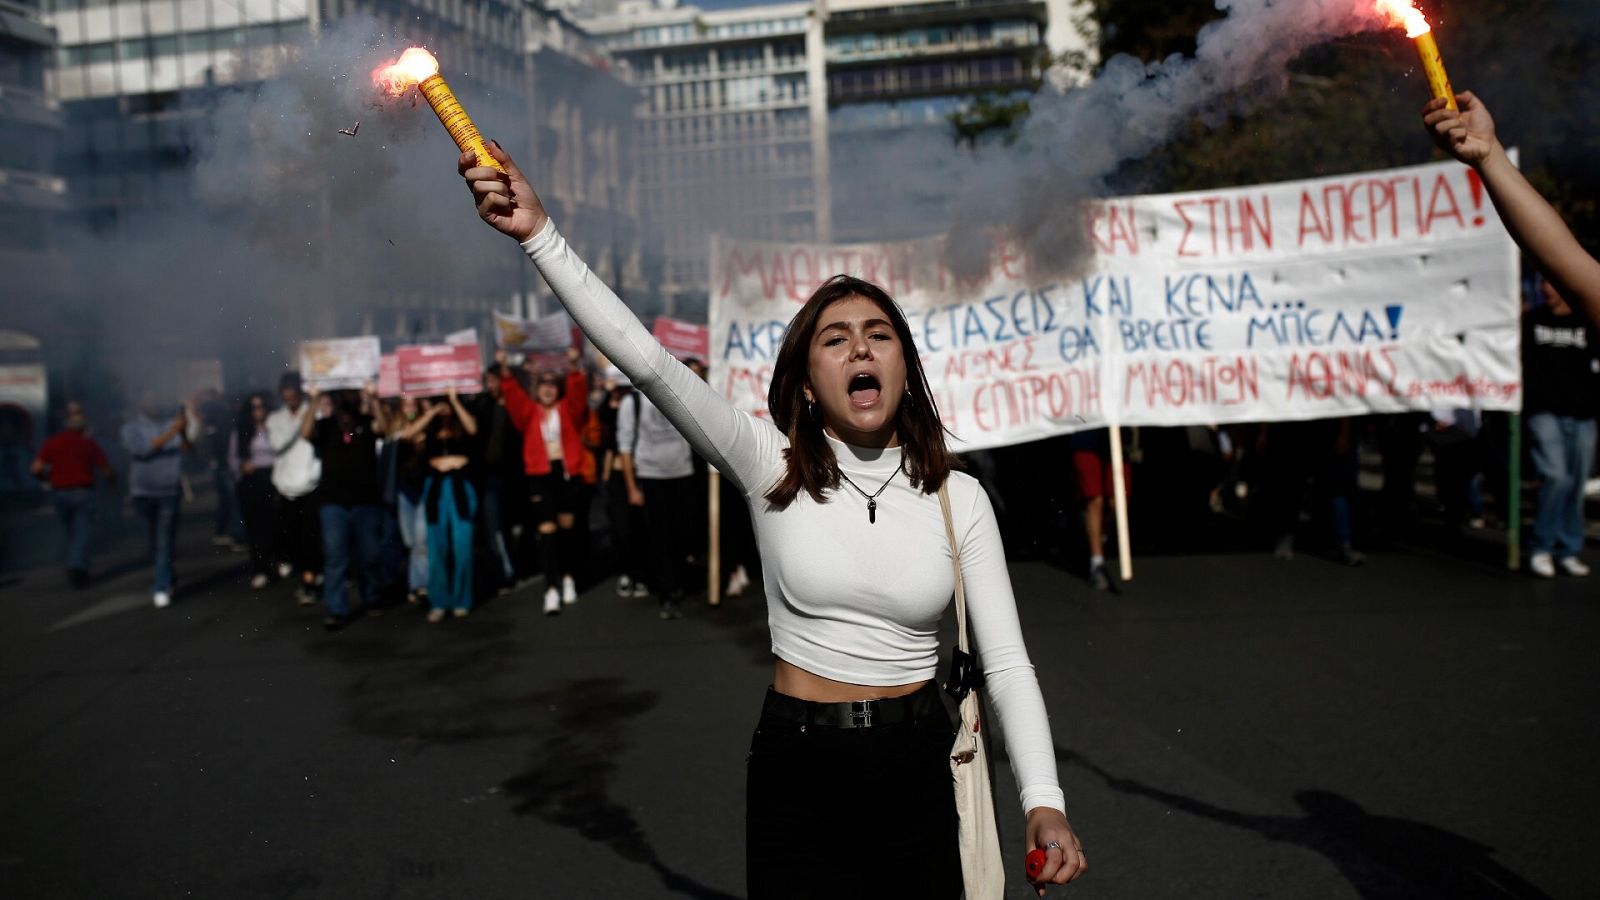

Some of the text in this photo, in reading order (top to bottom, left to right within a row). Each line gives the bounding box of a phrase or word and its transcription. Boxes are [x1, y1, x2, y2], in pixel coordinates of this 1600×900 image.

[1087, 203, 1140, 256] ΚΑΙ
[1173, 194, 1274, 258] ΣΤΗΝ
[1298, 167, 1486, 246] ΑΠΕΡΓΙΑ!
[1082, 274, 1132, 318] ΚΑΙ
[1164, 271, 1306, 318] ΚΕΝΑ...
[1058, 322, 1100, 362] ΘΑ
[1246, 304, 1404, 349] ΜΠΕΛΑ!
[1286, 345, 1400, 402] ΑΘΗΝΑΣ
